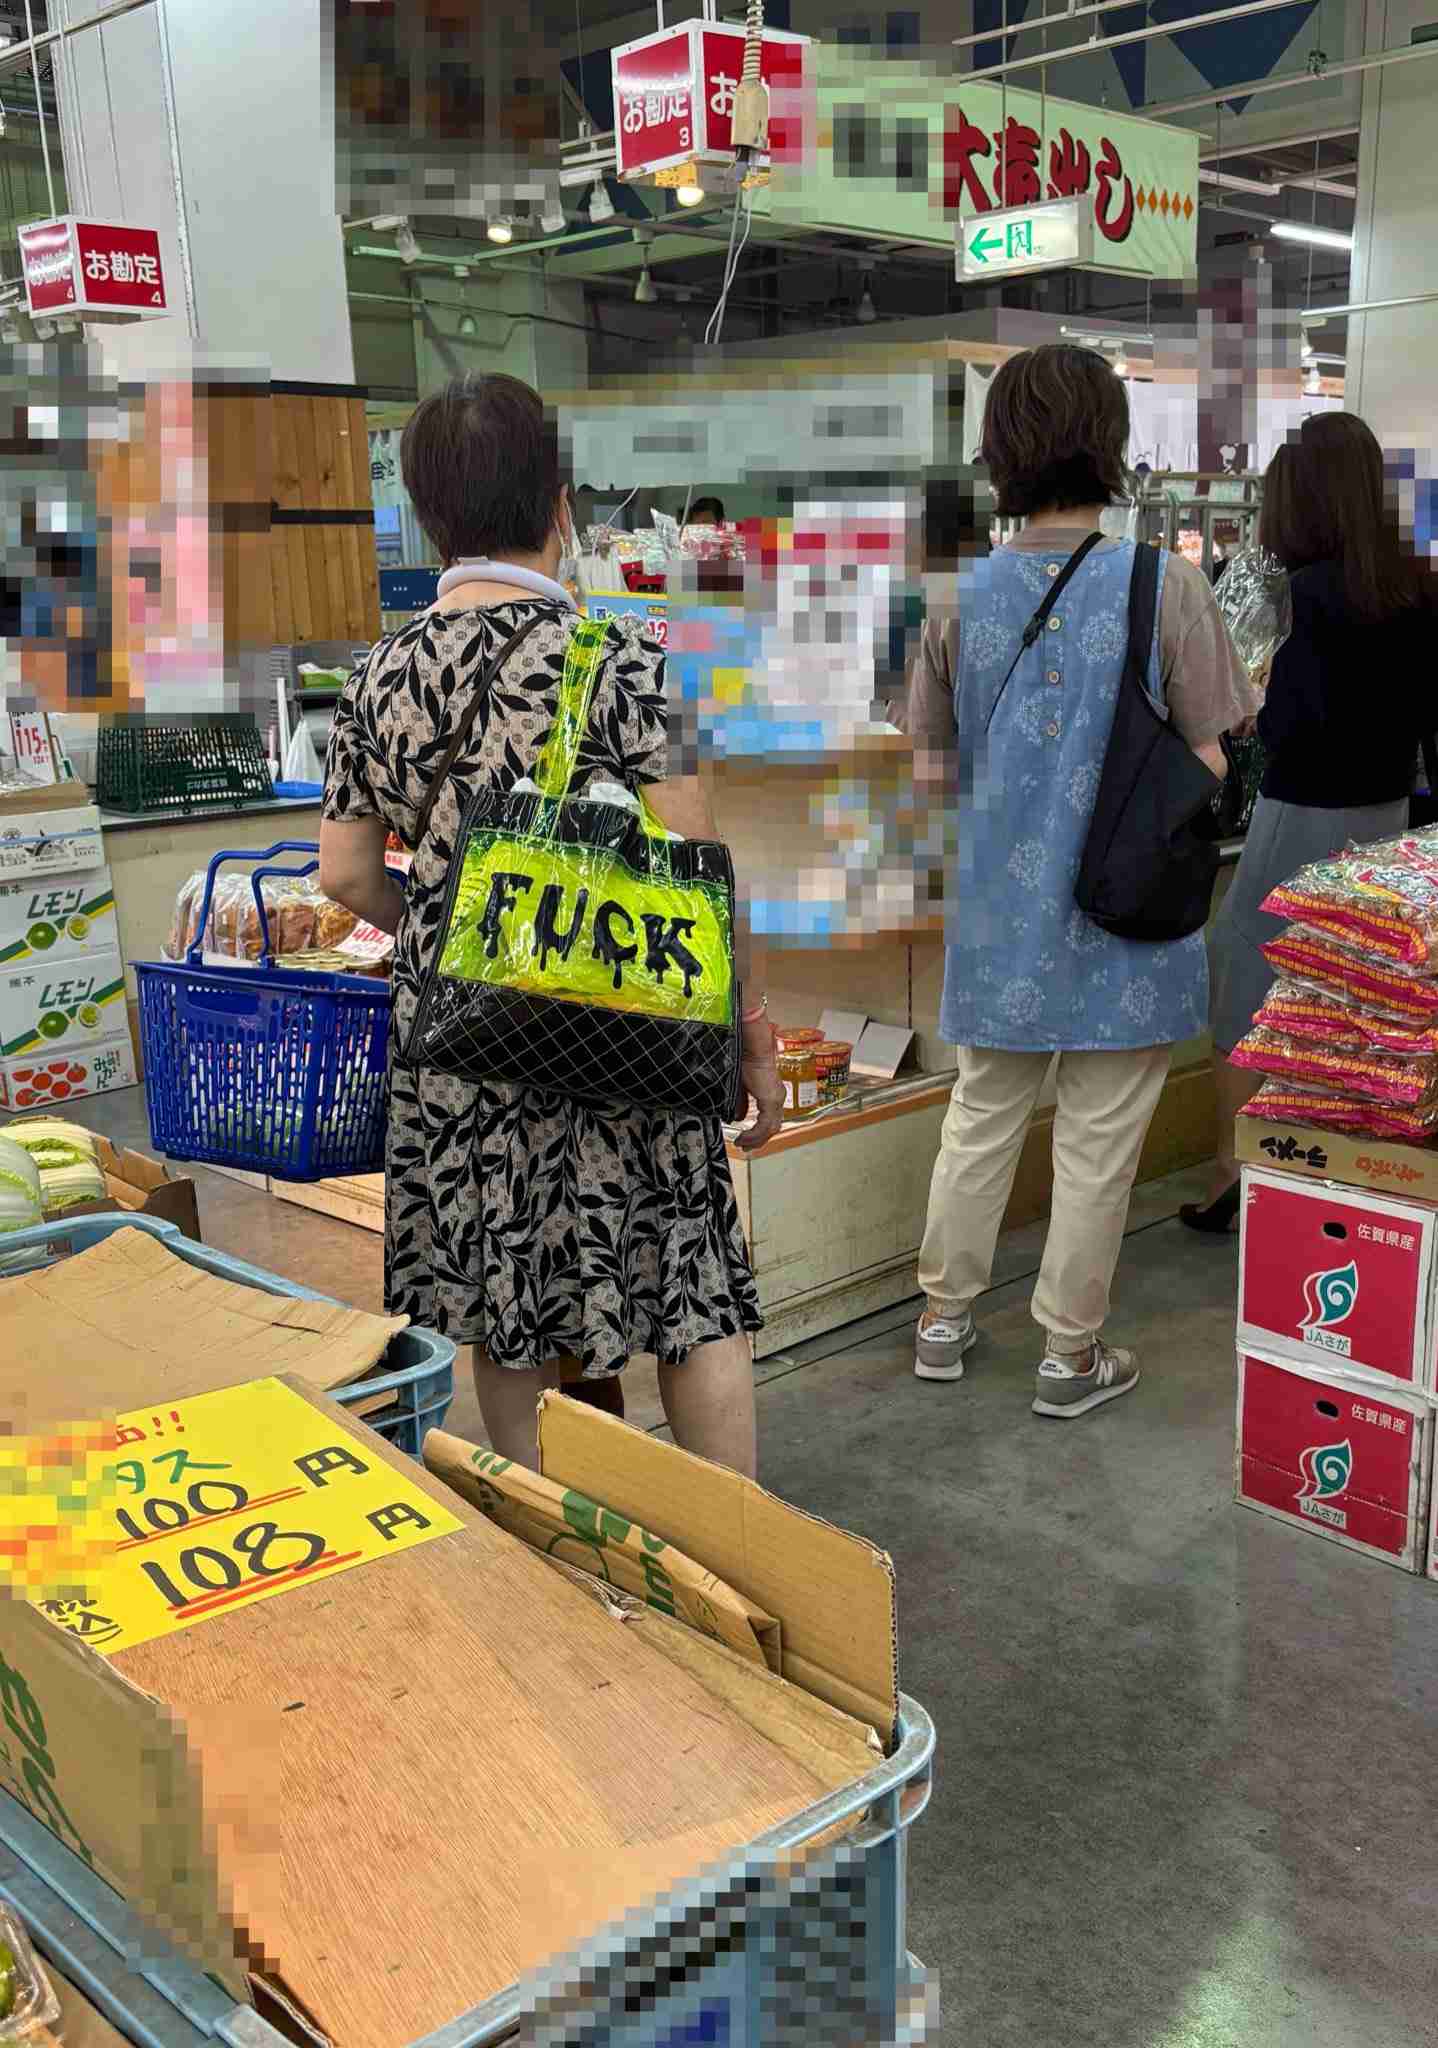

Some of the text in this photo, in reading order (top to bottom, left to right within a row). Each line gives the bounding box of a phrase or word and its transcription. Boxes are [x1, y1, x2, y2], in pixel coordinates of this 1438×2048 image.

[679, 126, 689, 147] 3
[84, 249, 161, 285] お勘定
[66, 285, 74, 300] 4
[151, 291, 162, 304] 4
[27, 887, 85, 919] レモン
[477, 872, 704, 999] FUCK
[38, 976, 95, 1009] レモン
[1357, 1223, 1415, 1251] 佐賀県産
[1305, 1328, 1349, 1352] JAさが
[1351, 1402, 1408, 1434] 佐賀県産
[1301, 1498, 1345, 1524] JAさが
